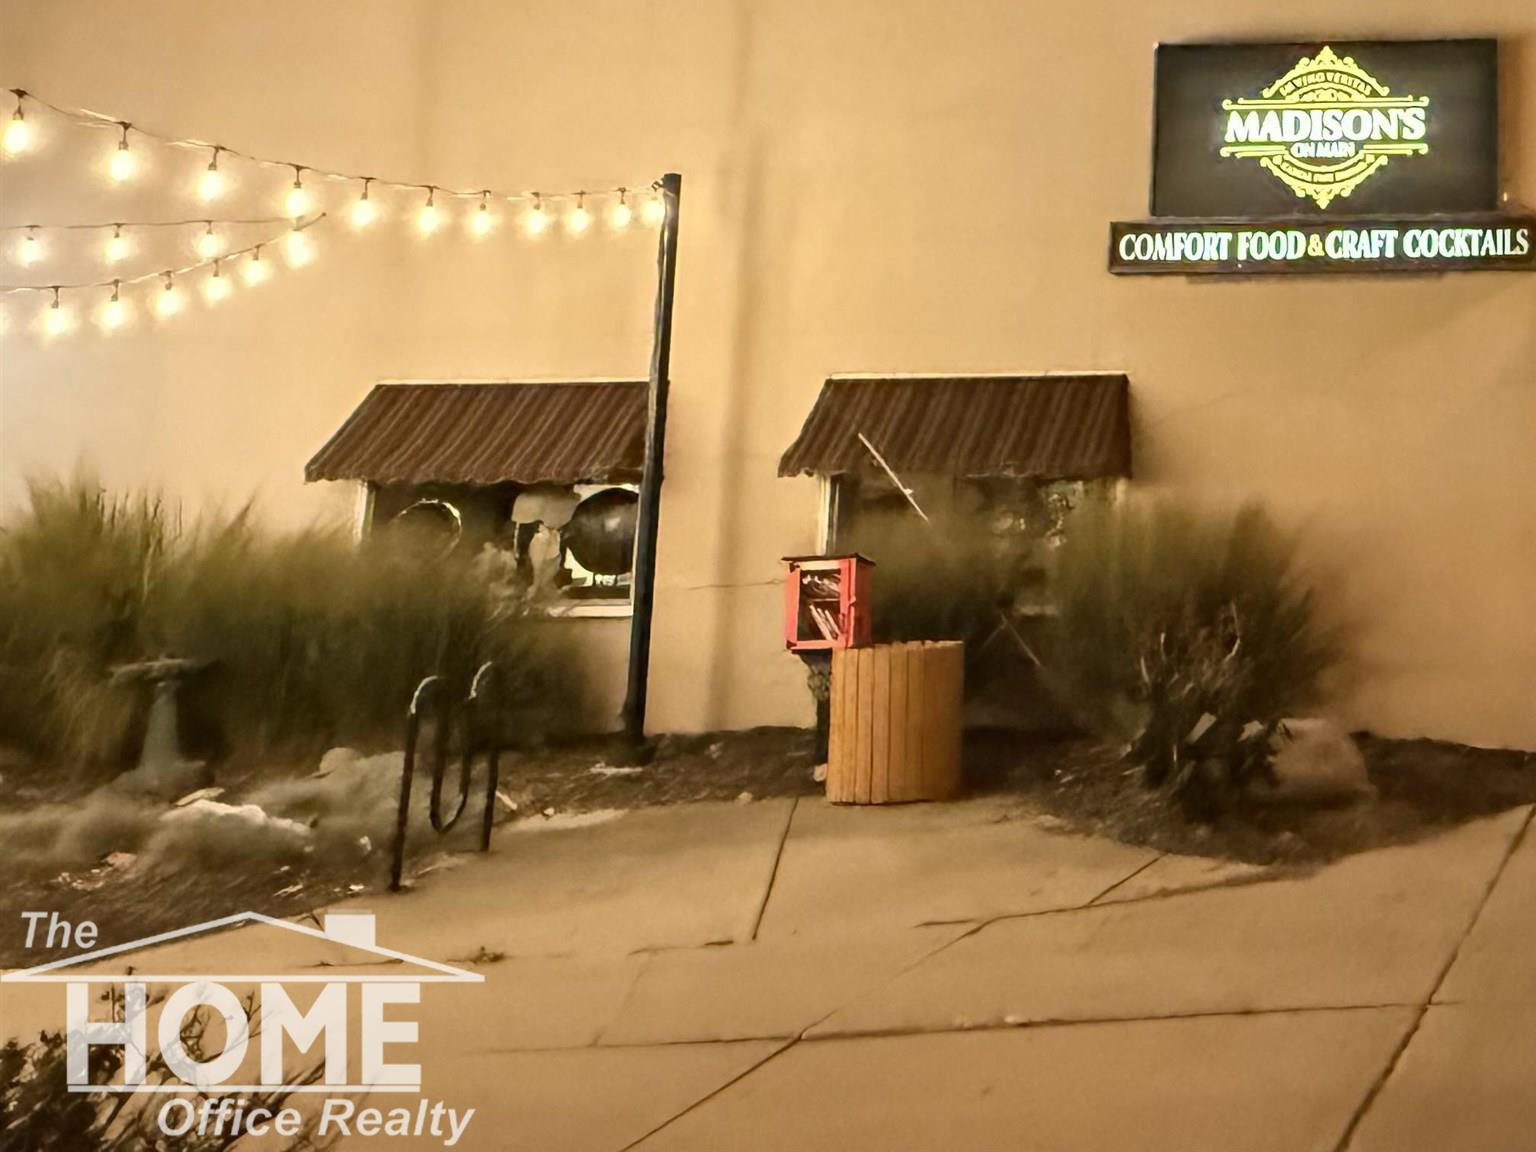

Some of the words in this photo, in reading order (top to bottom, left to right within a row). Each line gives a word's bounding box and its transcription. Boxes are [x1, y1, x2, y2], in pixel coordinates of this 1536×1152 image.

[1224, 107, 1426, 142] MADISON'S
[1291, 141, 1315, 158] ON
[1315, 141, 1355, 157] MAIN
[1119, 231, 1233, 261] COMFORT
[1403, 228, 1530, 258] COCKTAILS
